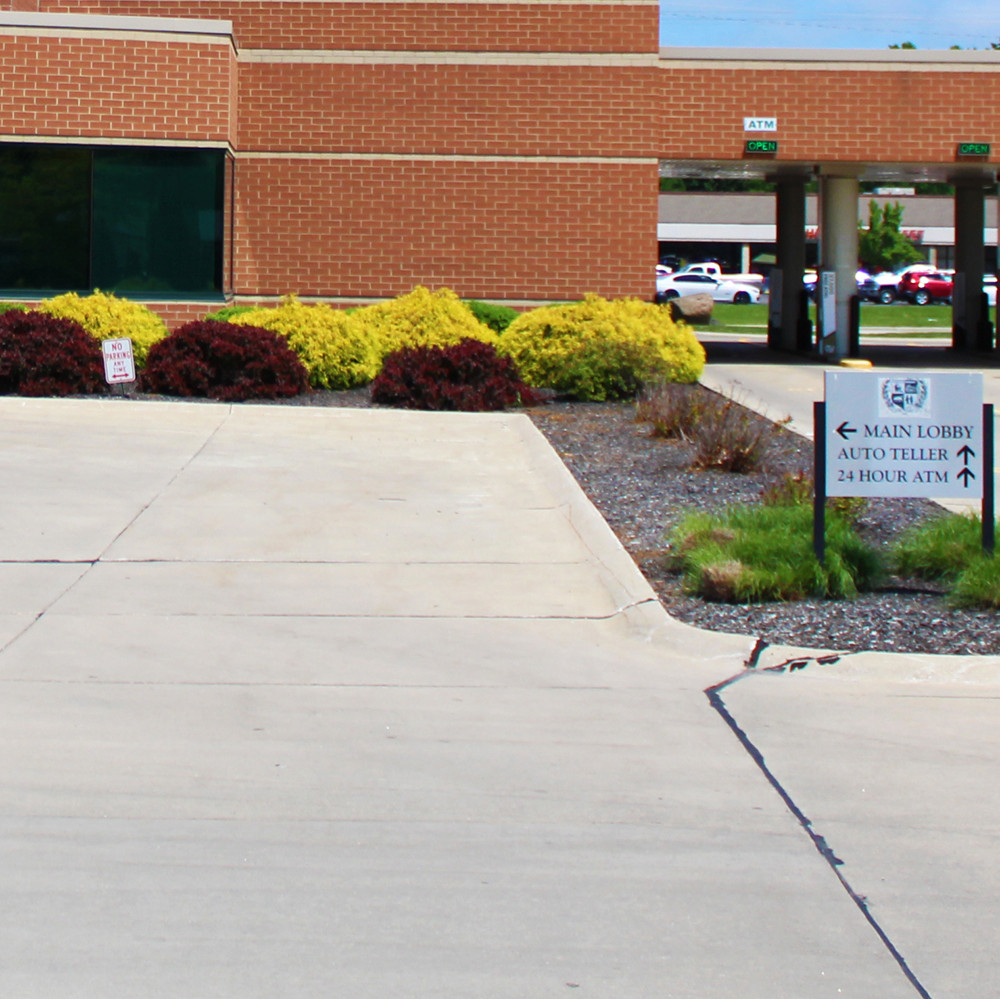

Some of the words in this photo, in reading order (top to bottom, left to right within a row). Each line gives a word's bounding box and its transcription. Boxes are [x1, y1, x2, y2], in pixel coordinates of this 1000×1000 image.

[748, 120, 775, 129] ATM
[748, 141, 776, 151] OPEN
[961, 143, 988, 154] OPEN
[111, 342, 123, 351] NO
[864, 424, 912, 438] MAIN
[917, 425, 974, 439] LOBBY
[837, 447, 886, 460] AUTO
[889, 447, 948, 461] TELLER
[837, 469, 854, 482] 24
[859, 469, 908, 483] HOUR
[912, 470, 949, 483] ATM
